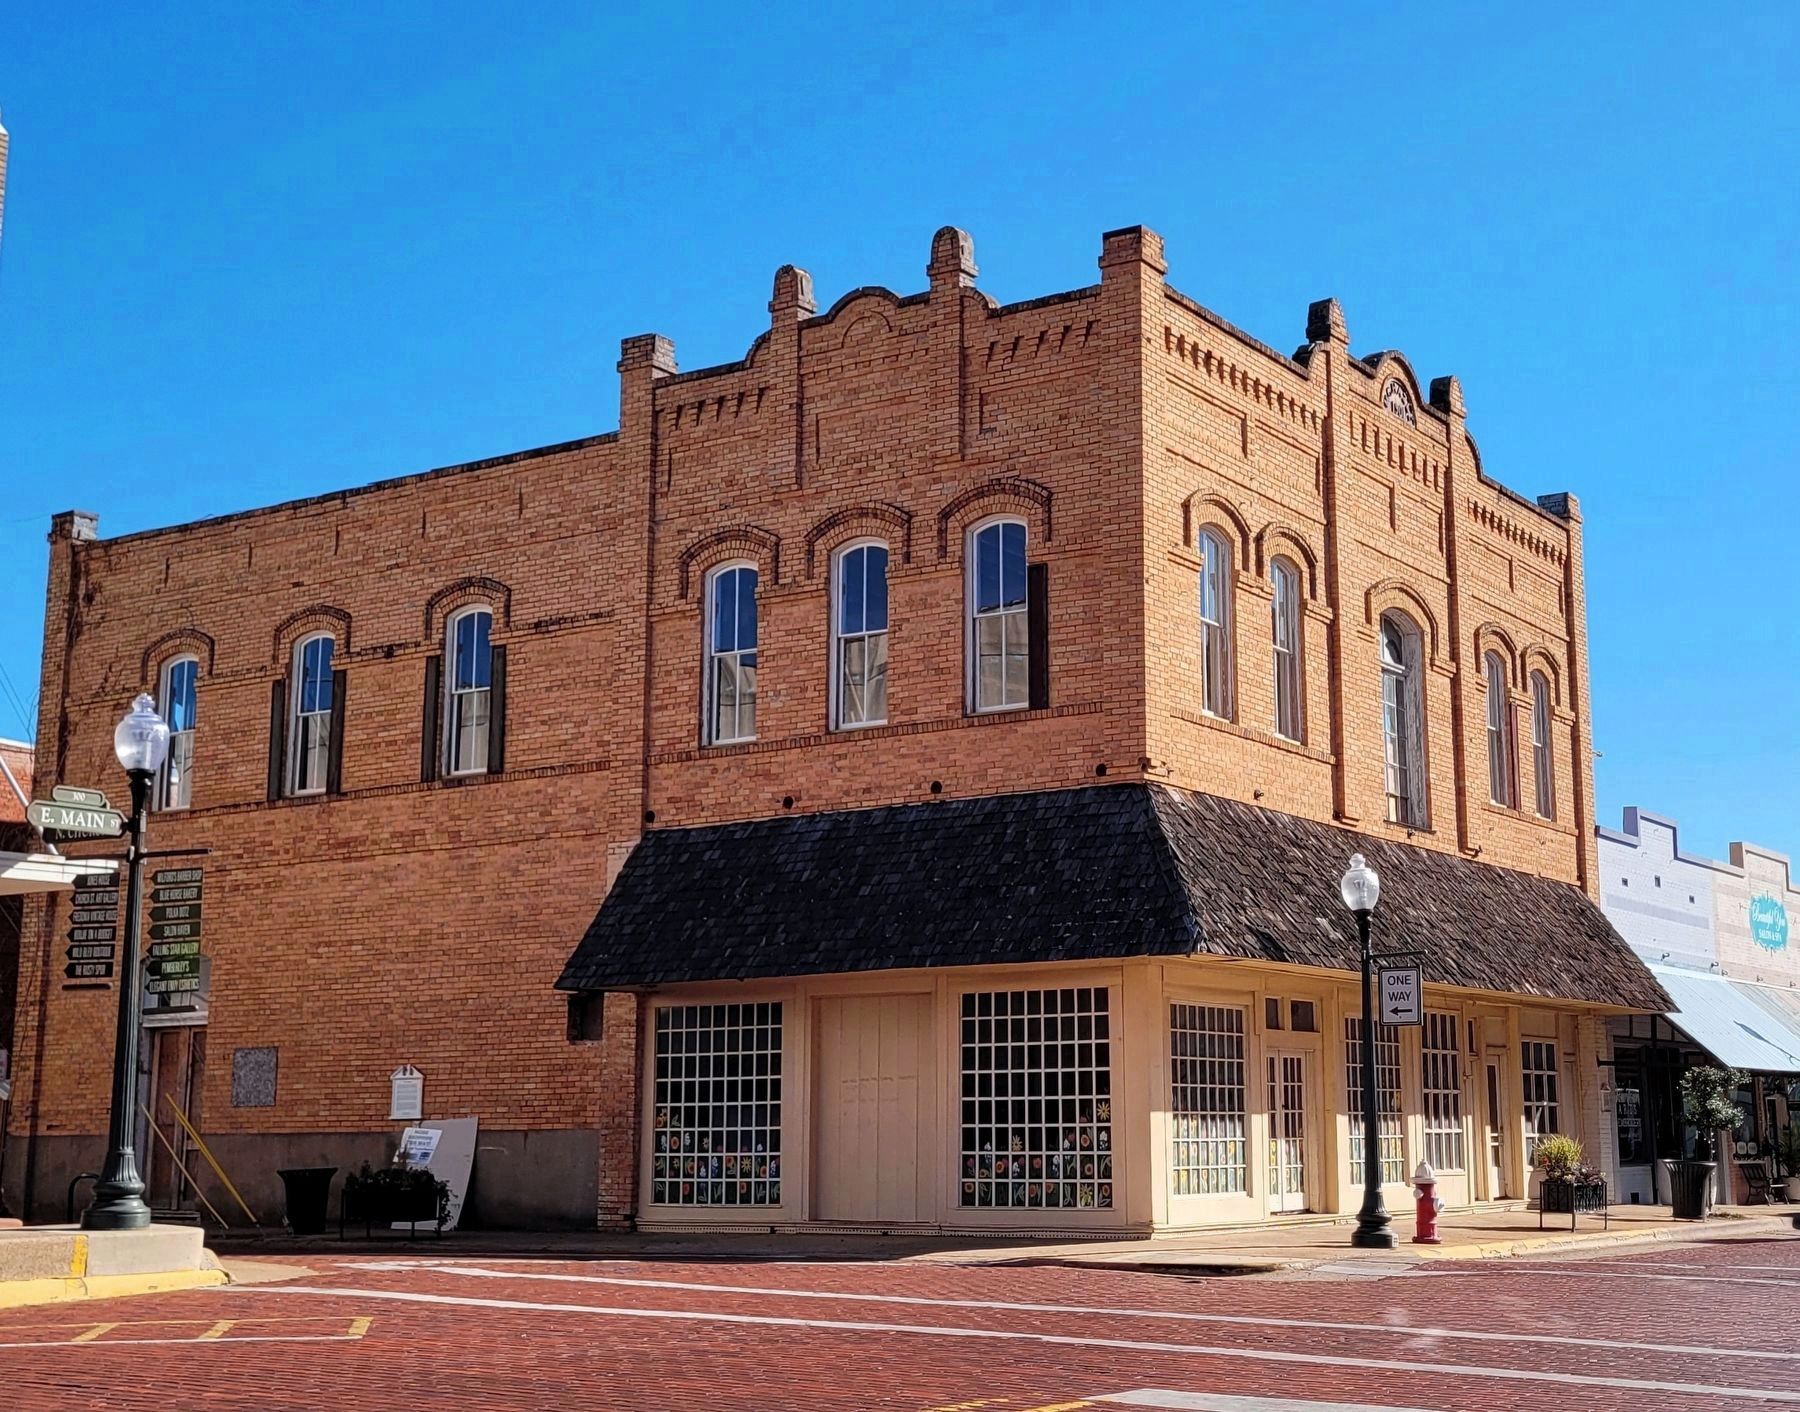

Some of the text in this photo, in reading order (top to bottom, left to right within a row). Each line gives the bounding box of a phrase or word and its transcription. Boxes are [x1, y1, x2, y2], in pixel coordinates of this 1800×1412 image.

[41, 807, 55, 823] E.
[61, 809, 105, 829] MAIN
[170, 943, 180, 954] STAR
[180, 942, 199, 954] GALLERY
[1387, 975, 1412, 986] ONE
[1388, 990, 1412, 1002] WAY
